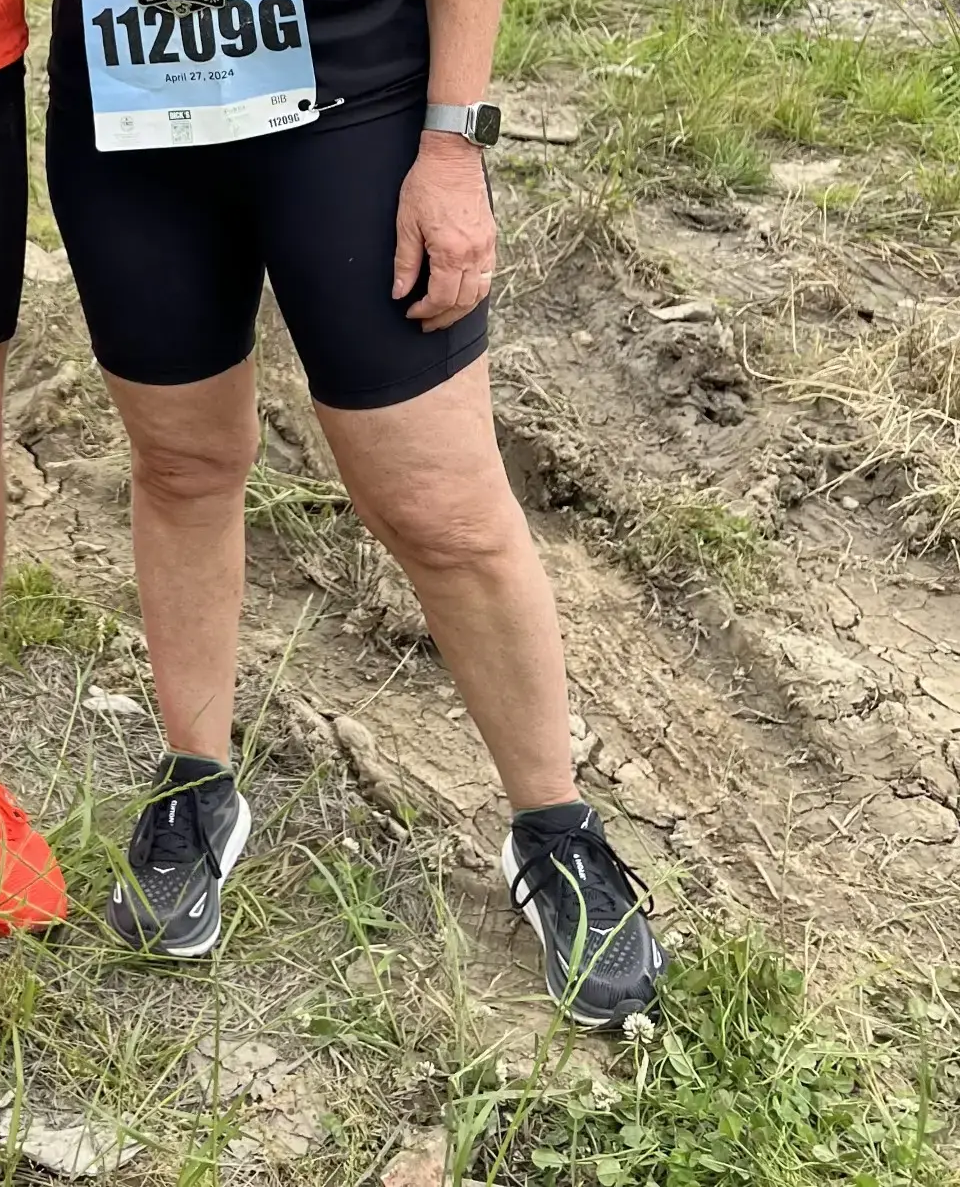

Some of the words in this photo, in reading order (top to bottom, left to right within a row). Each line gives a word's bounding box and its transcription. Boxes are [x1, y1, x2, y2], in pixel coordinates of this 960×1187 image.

[165, 72, 187, 84] April
[189, 72, 206, 83] 27,
[209, 69, 235, 80] 2024
[270, 94, 287, 106] BIB
[267, 114, 300, 128] 11209G
